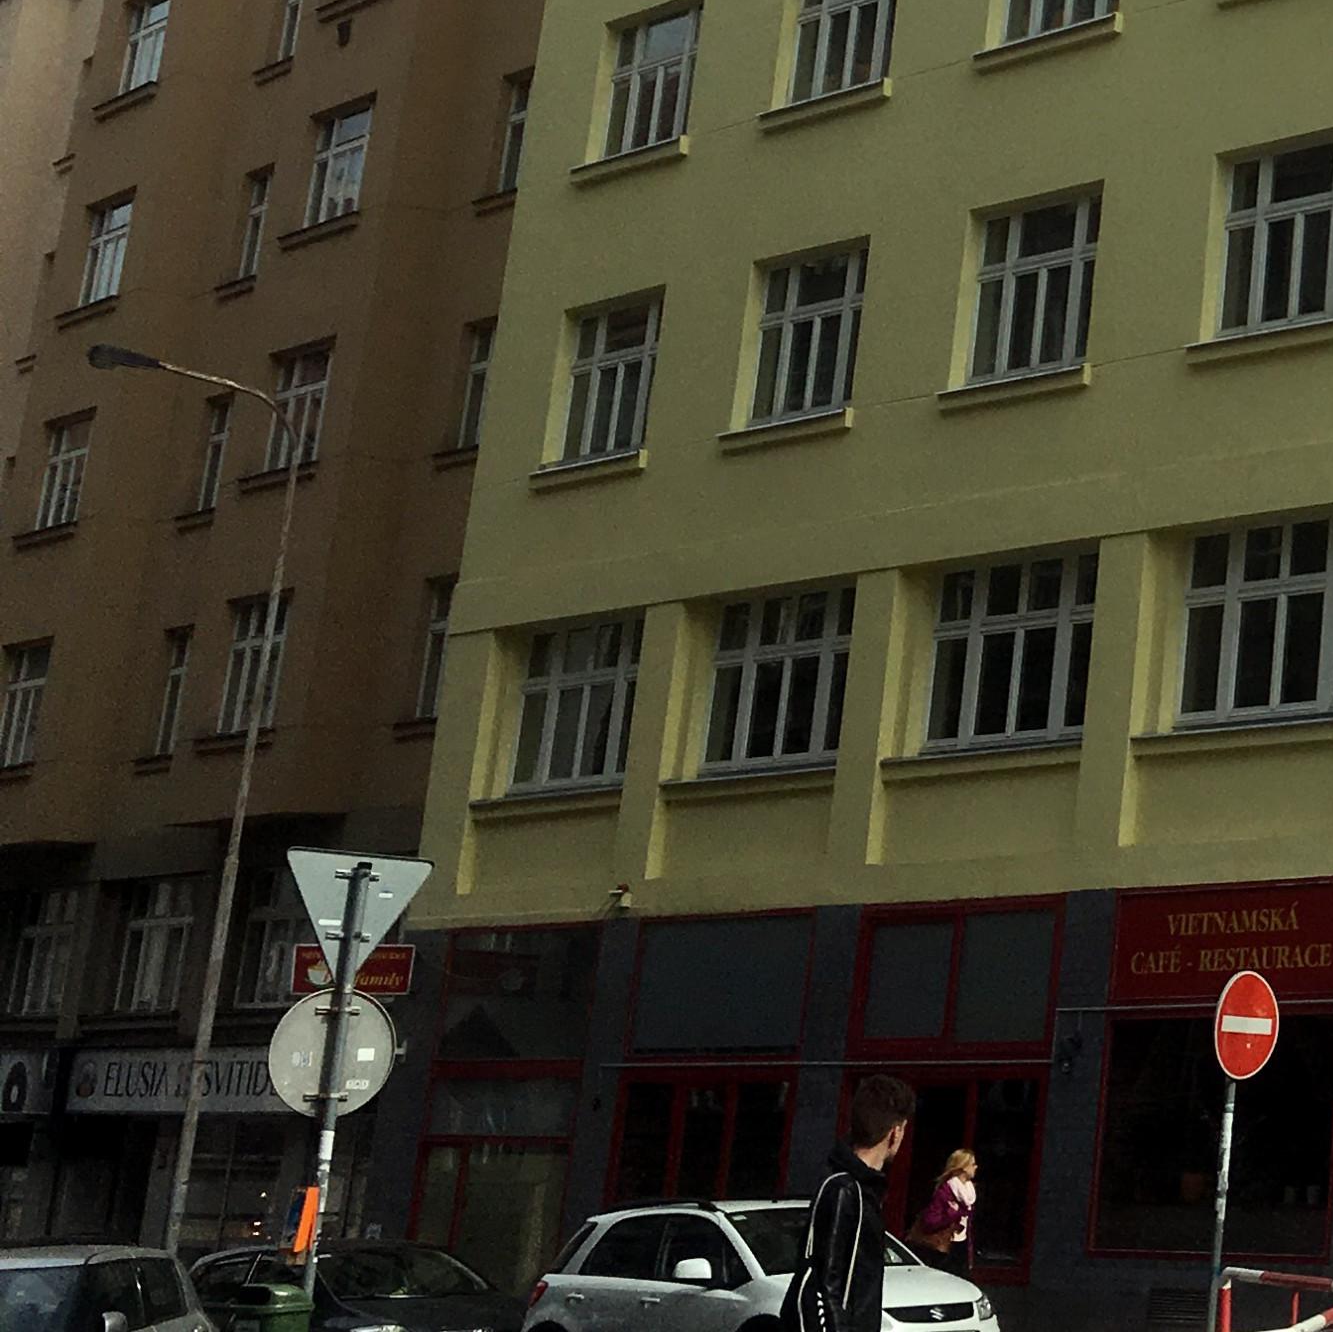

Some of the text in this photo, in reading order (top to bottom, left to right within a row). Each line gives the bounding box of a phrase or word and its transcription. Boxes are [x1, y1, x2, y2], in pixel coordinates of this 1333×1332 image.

[1167, 901, 1300, 936] VIETNAMSKÁ
[1130, 944, 1182, 974] CAFÉ
[1198, 943, 1333, 972] RESTAURACE
